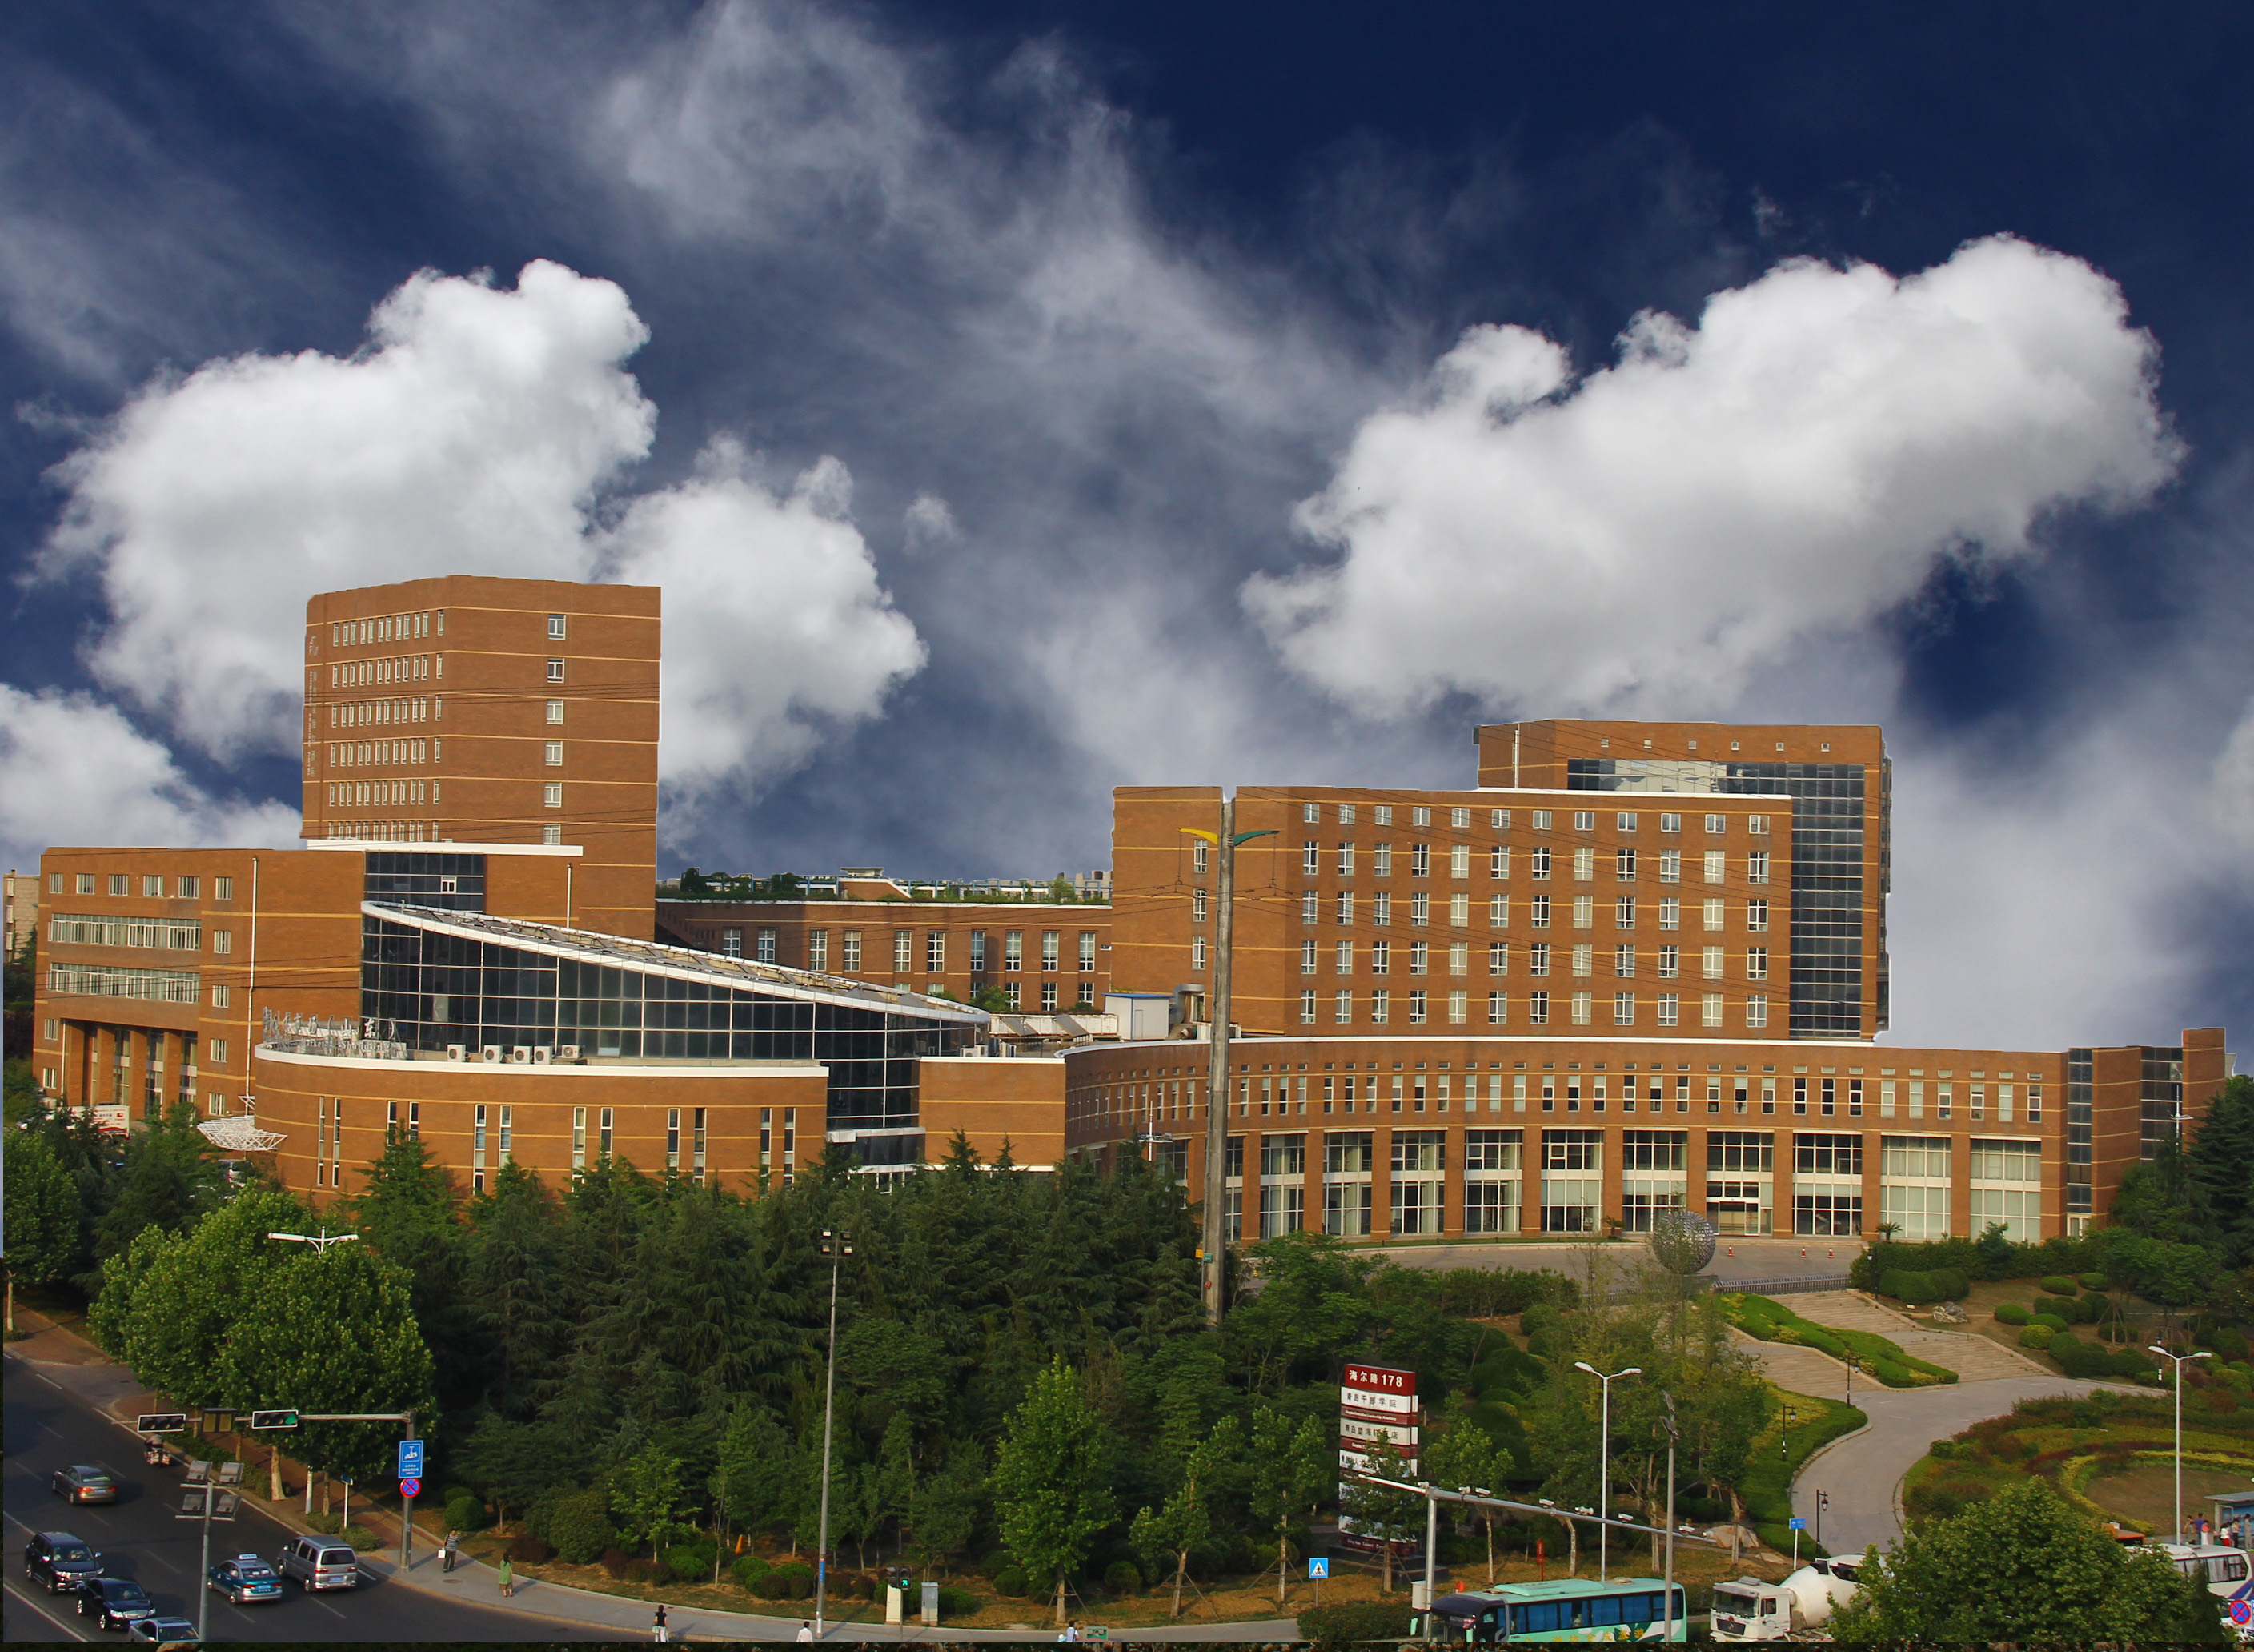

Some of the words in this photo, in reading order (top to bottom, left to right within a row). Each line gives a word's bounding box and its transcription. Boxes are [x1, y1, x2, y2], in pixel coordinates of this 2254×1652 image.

[1349, 1369, 1378, 1385] 海尔路
[1382, 1374, 1402, 1388] 178
